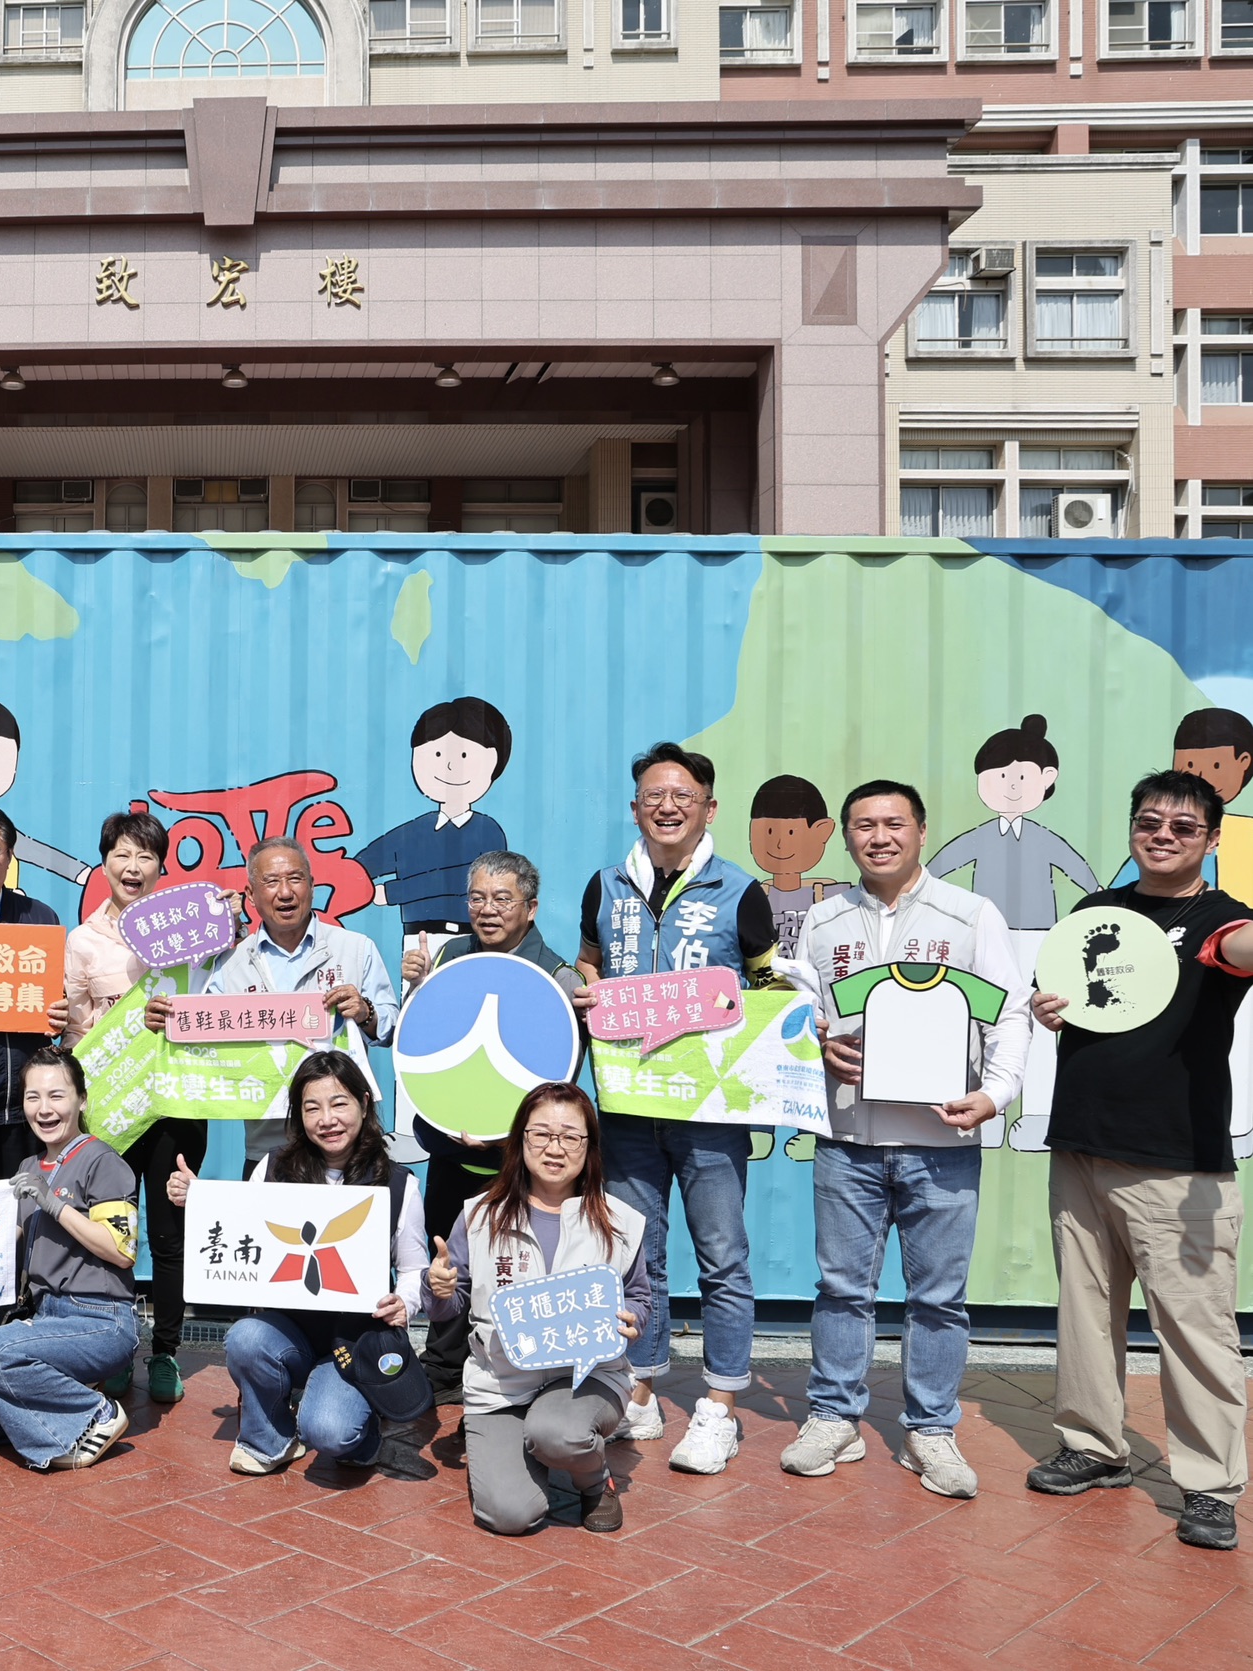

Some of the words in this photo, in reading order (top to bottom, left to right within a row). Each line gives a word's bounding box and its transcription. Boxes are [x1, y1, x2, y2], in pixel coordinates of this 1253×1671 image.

[96, 254, 365, 309] 致宏樓
[134, 901, 200, 937] 舊鞋救命
[671, 899, 718, 971] 李伯
[149, 922, 219, 959] 改變生命
[622, 896, 642, 976] 市議員參
[853, 940, 866, 961] 助理
[926, 939, 951, 963] 陳
[1096, 964, 1135, 977] 舊鞋救命
[599, 977, 700, 1009] 裝的是物資
[176, 1009, 298, 1033] 舊鞋最佳夥伴
[601, 1002, 704, 1031] 送的是希望
[183, 1045, 218, 1059] 2026
[153, 1072, 266, 1104] 改變生命
[593, 1064, 698, 1102] 變生命
[782, 1099, 826, 1122] TAINAN
[199, 1220, 263, 1266] 臺南
[204, 1268, 259, 1282] TAINAN
[518, 1250, 531, 1273] 秘書
[503, 1281, 611, 1325] 貨櫃改建
[541, 1317, 616, 1354] 交給我
